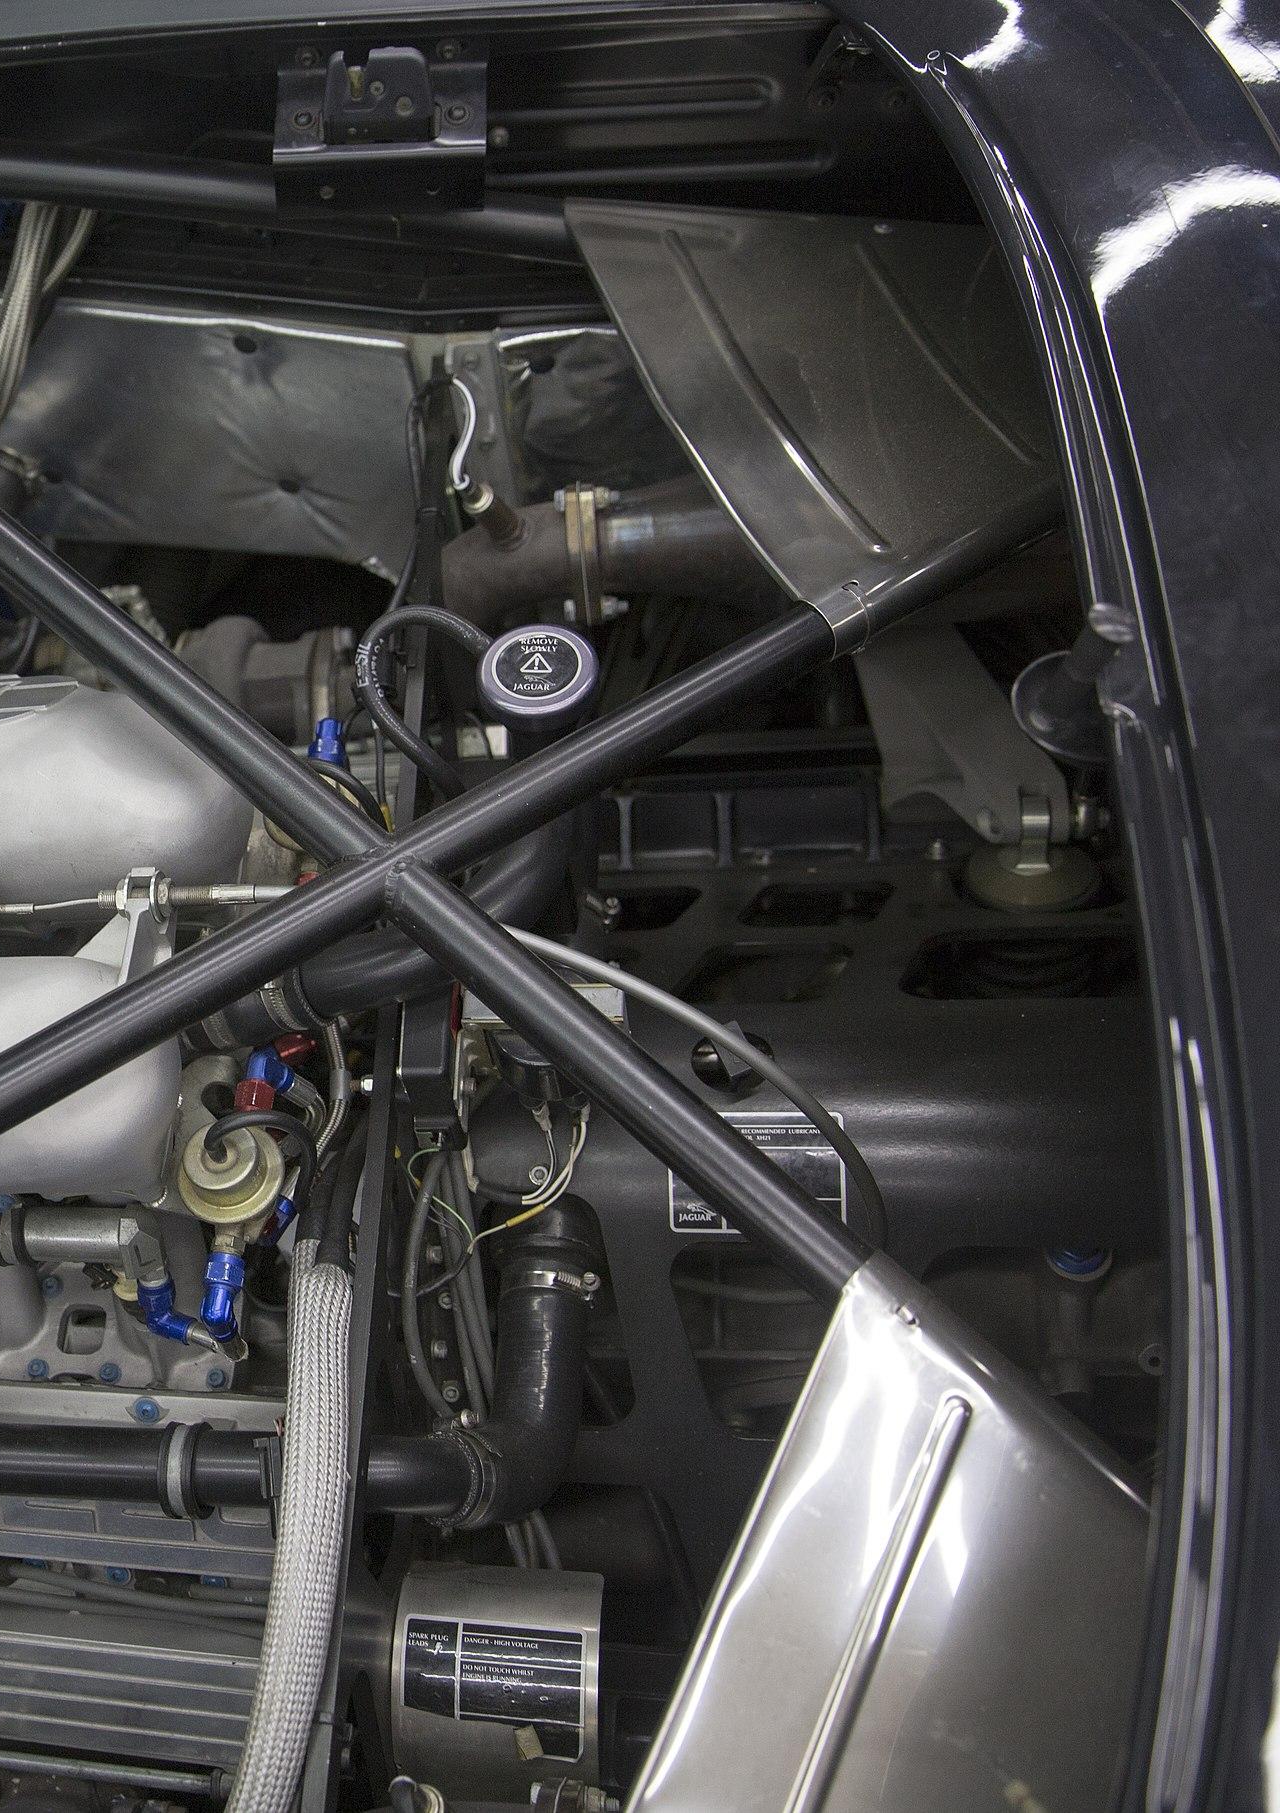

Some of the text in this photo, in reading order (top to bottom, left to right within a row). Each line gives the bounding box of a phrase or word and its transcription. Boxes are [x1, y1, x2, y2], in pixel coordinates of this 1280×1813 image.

[520, 645, 558, 653] SLOWLY
[513, 683, 550, 691] JAGUAR
[679, 1213, 712, 1223] JAGUAR
[408, 1631, 449, 1642] SPARK PLUG
[408, 1639, 429, 1647] LEADS
[464, 1637, 490, 1645] DANGER
[493, 1639, 510, 1647] HIGH
[511, 1641, 539, 1650] VOLTAGE
[488, 1666, 511, 1674] TOUCH
[511, 1668, 535, 1676] WHILST
[462, 1672, 484, 1680] ENGINE
[492, 1674, 522, 1684] RUNNING
